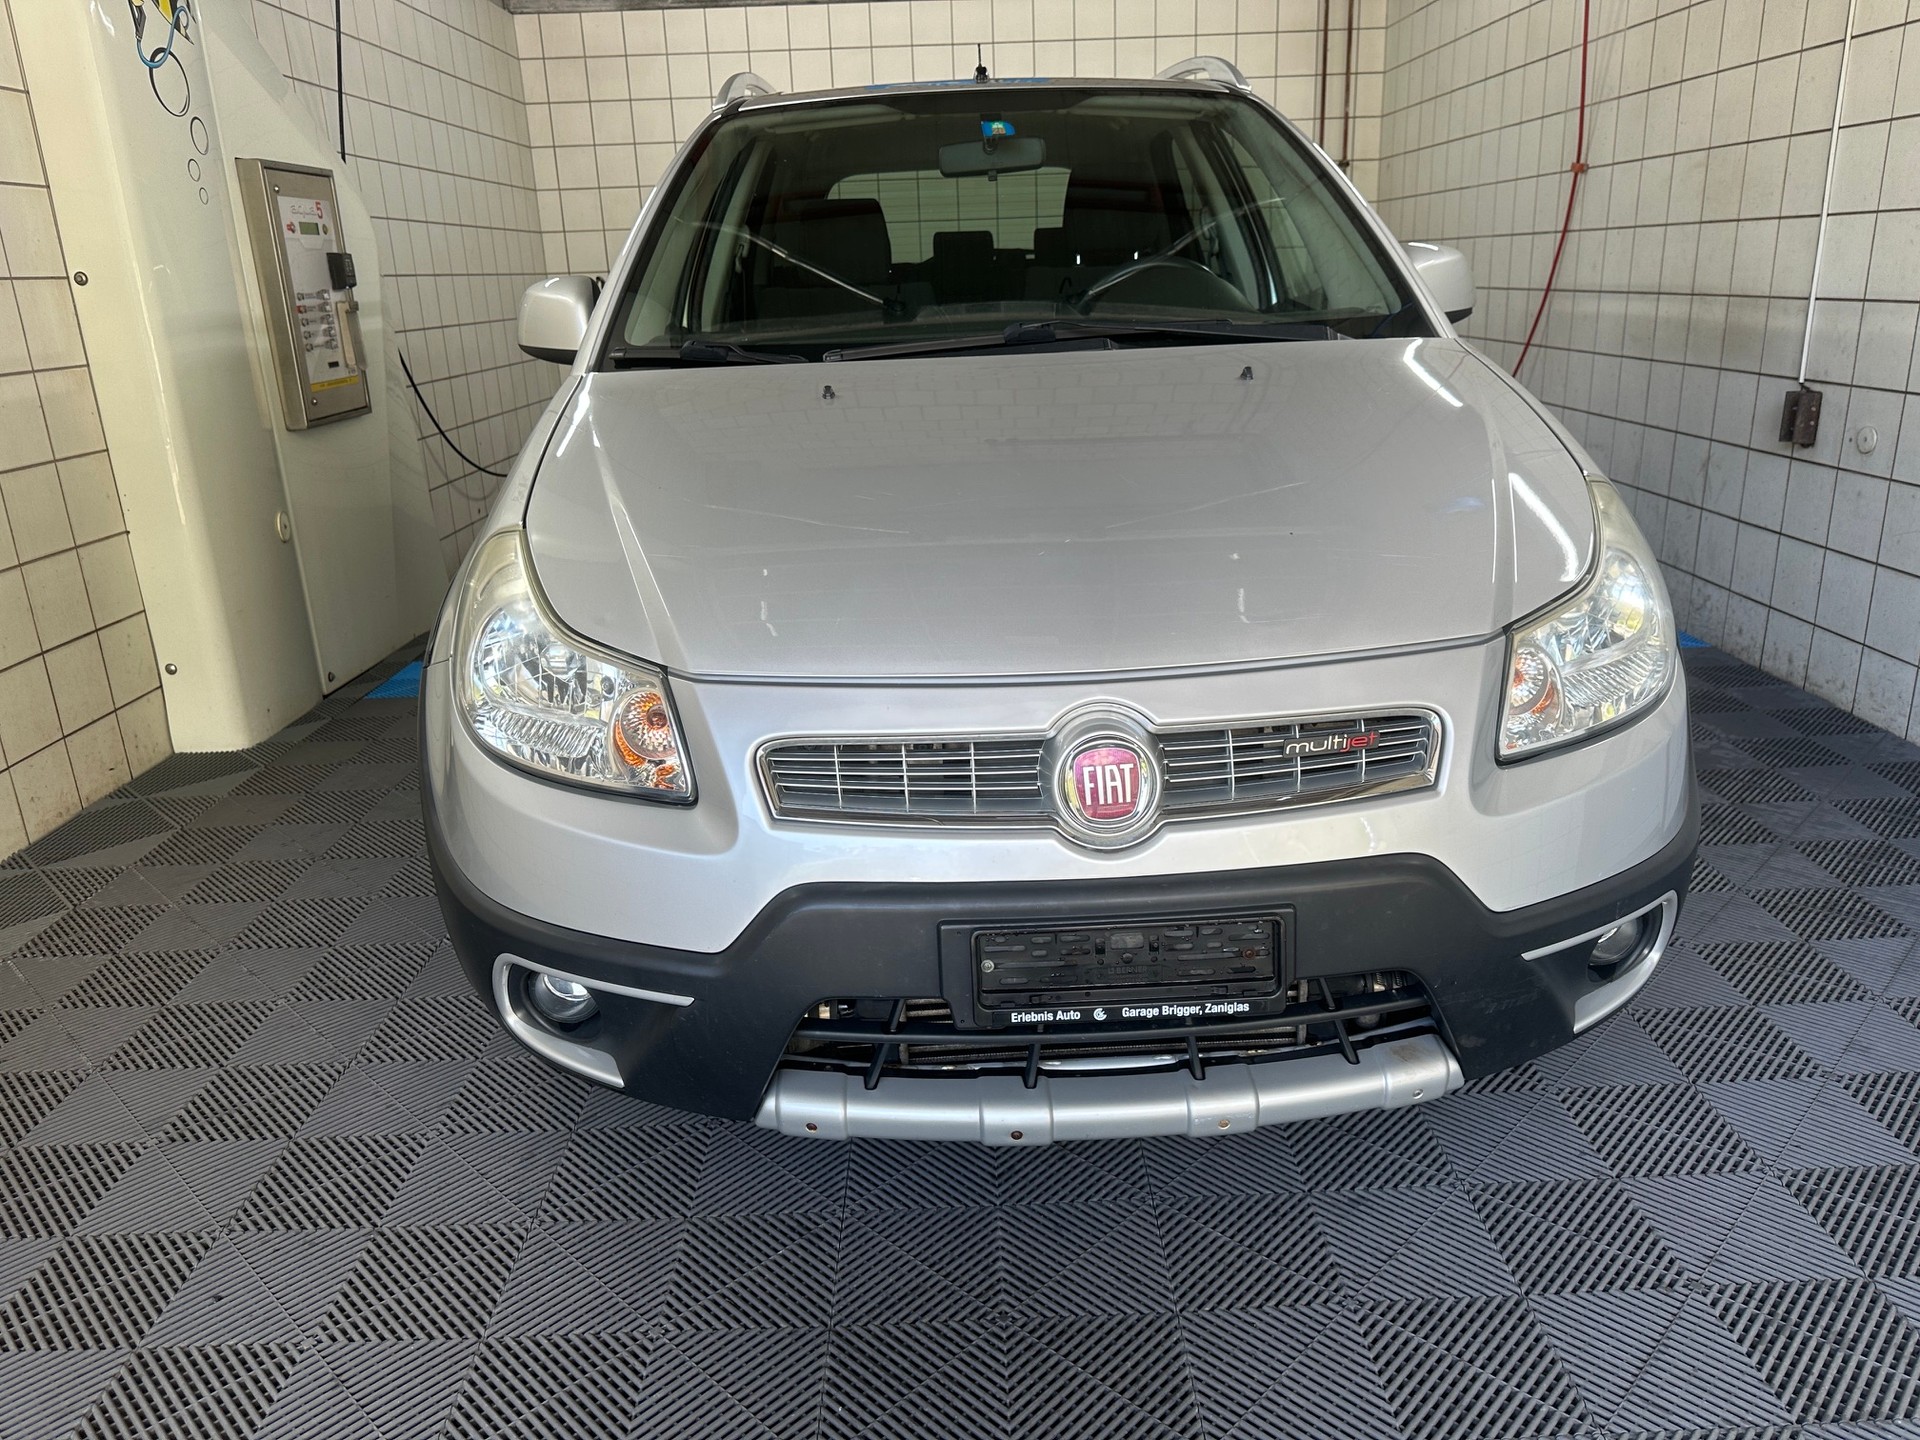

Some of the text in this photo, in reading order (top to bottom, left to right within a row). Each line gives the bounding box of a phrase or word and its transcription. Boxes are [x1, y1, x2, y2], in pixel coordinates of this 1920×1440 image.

[1286, 731, 1379, 755] multijet
[1082, 763, 1134, 806] FIAT
[1011, 1010, 1081, 1023] Erlebnis Auto
[1121, 1002, 1250, 1018] Garage Brigger, Zaniglas
